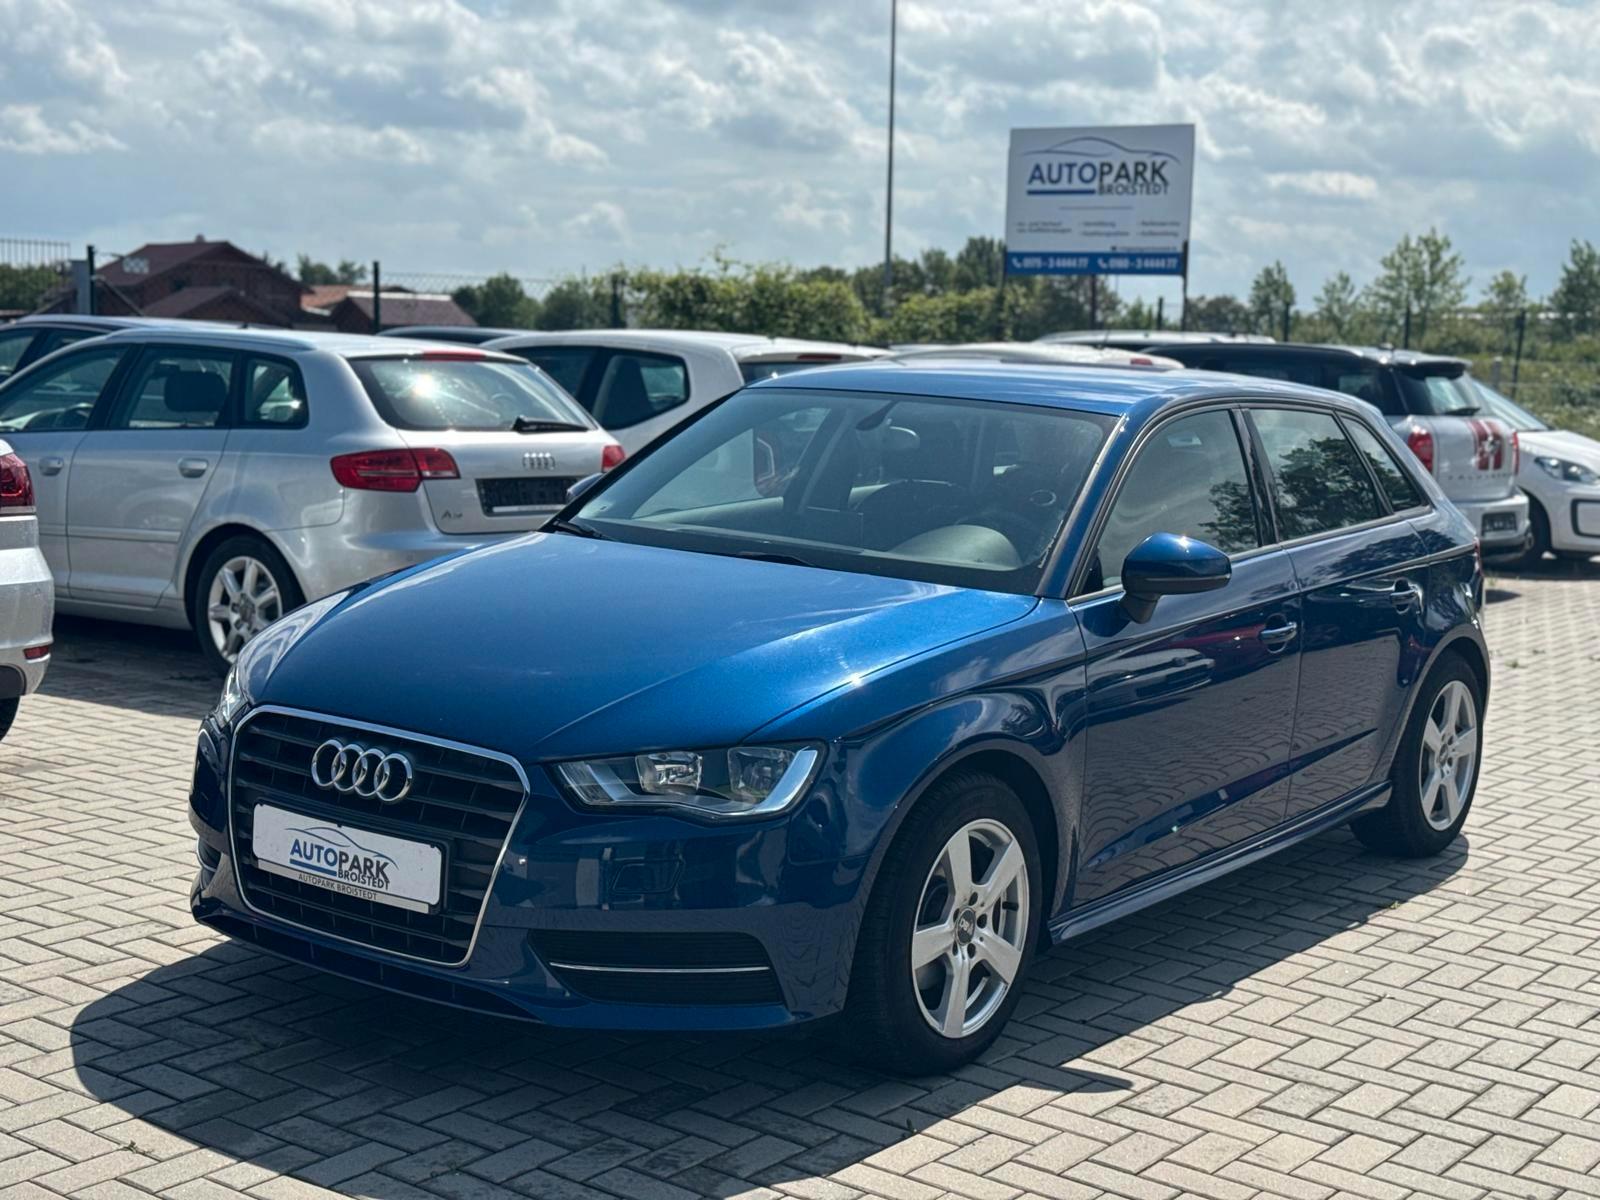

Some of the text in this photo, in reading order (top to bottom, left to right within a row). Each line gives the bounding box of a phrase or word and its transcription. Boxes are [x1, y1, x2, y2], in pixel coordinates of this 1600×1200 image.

[1028, 161, 1169, 187] AUTOPARK
[1098, 183, 1168, 196] BROISTEDT
[290, 838, 390, 884] AUTOPARK
[298, 873, 378, 900] AUTOPARK BROISTEDT
[338, 869, 390, 890] BROISTEDT
